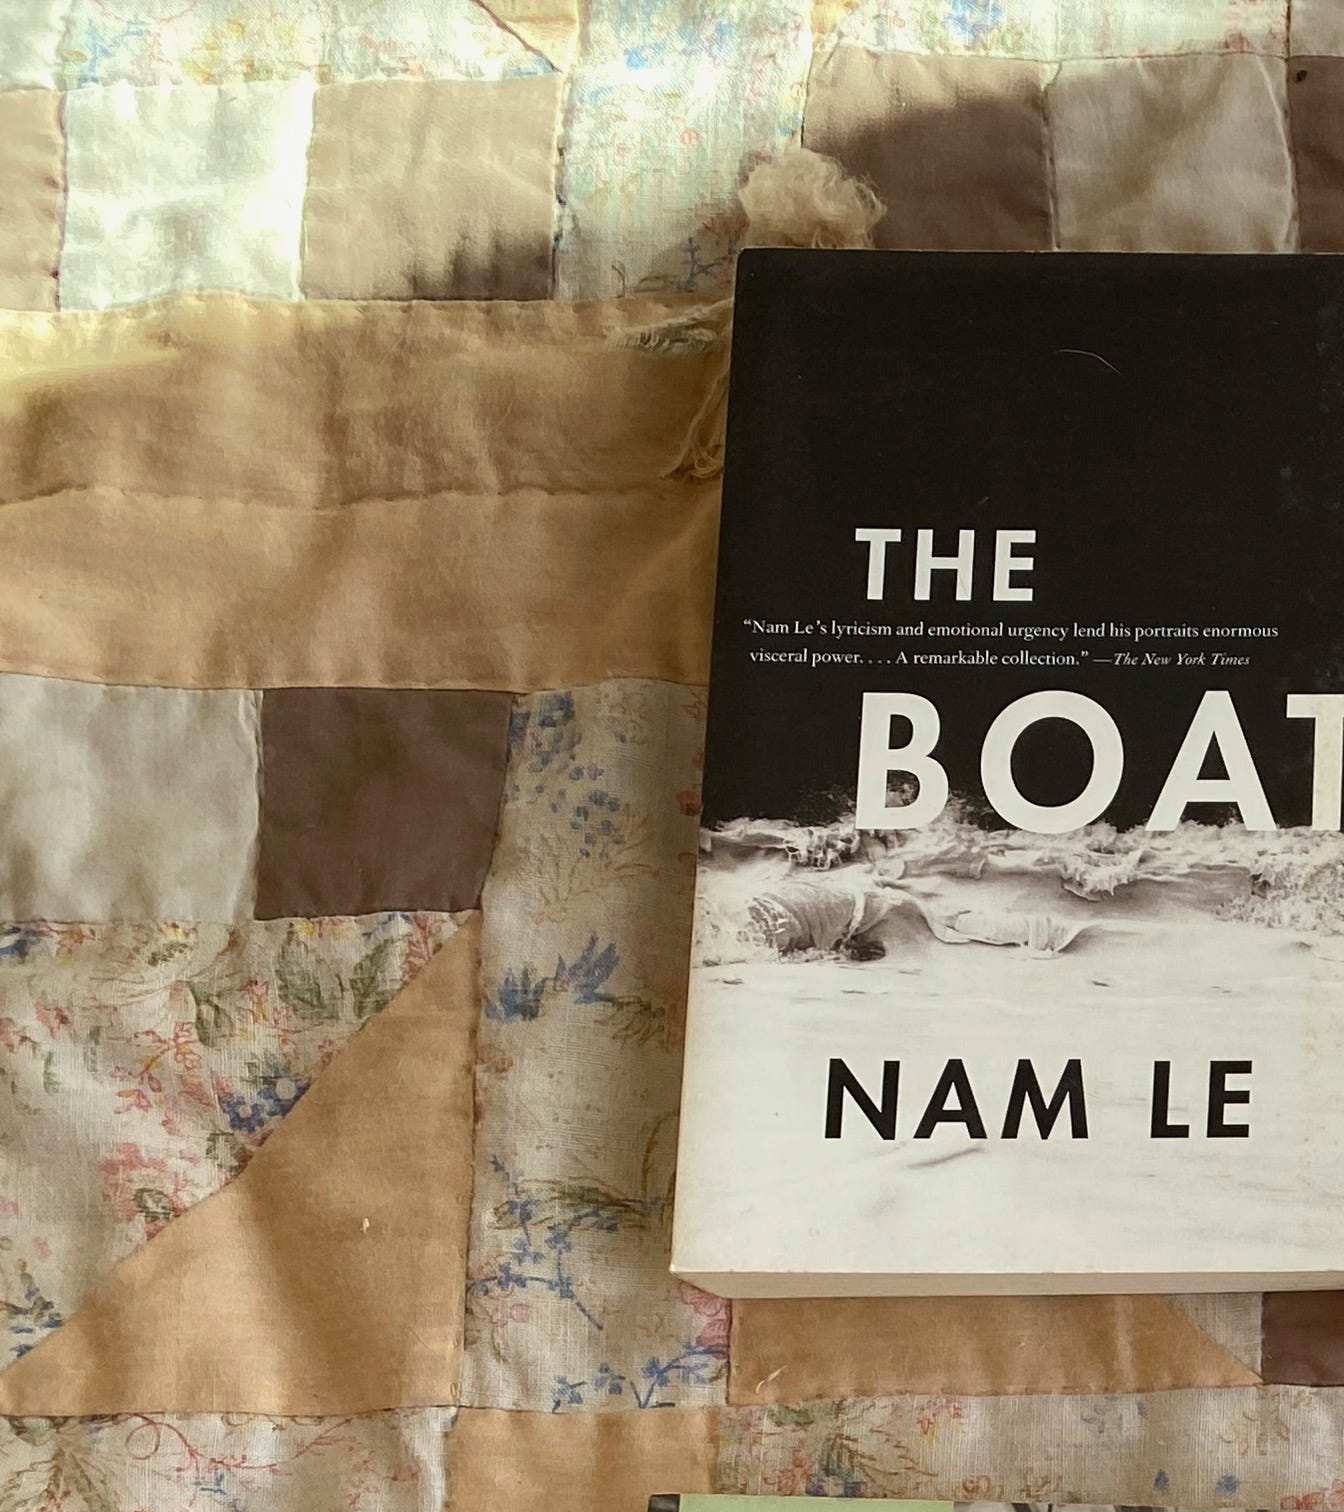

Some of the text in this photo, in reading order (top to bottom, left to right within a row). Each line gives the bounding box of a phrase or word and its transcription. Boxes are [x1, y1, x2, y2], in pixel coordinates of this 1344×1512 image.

[854, 528, 1037, 601] THE
[743, 618, 1279, 642] “Nam Le’s lyricism and emotional urgency lend his portraits enormous
[750, 648, 1251, 667] visceral A remarkable collection.” New York Times
[824, 1057, 1253, 1141] NAM LE
